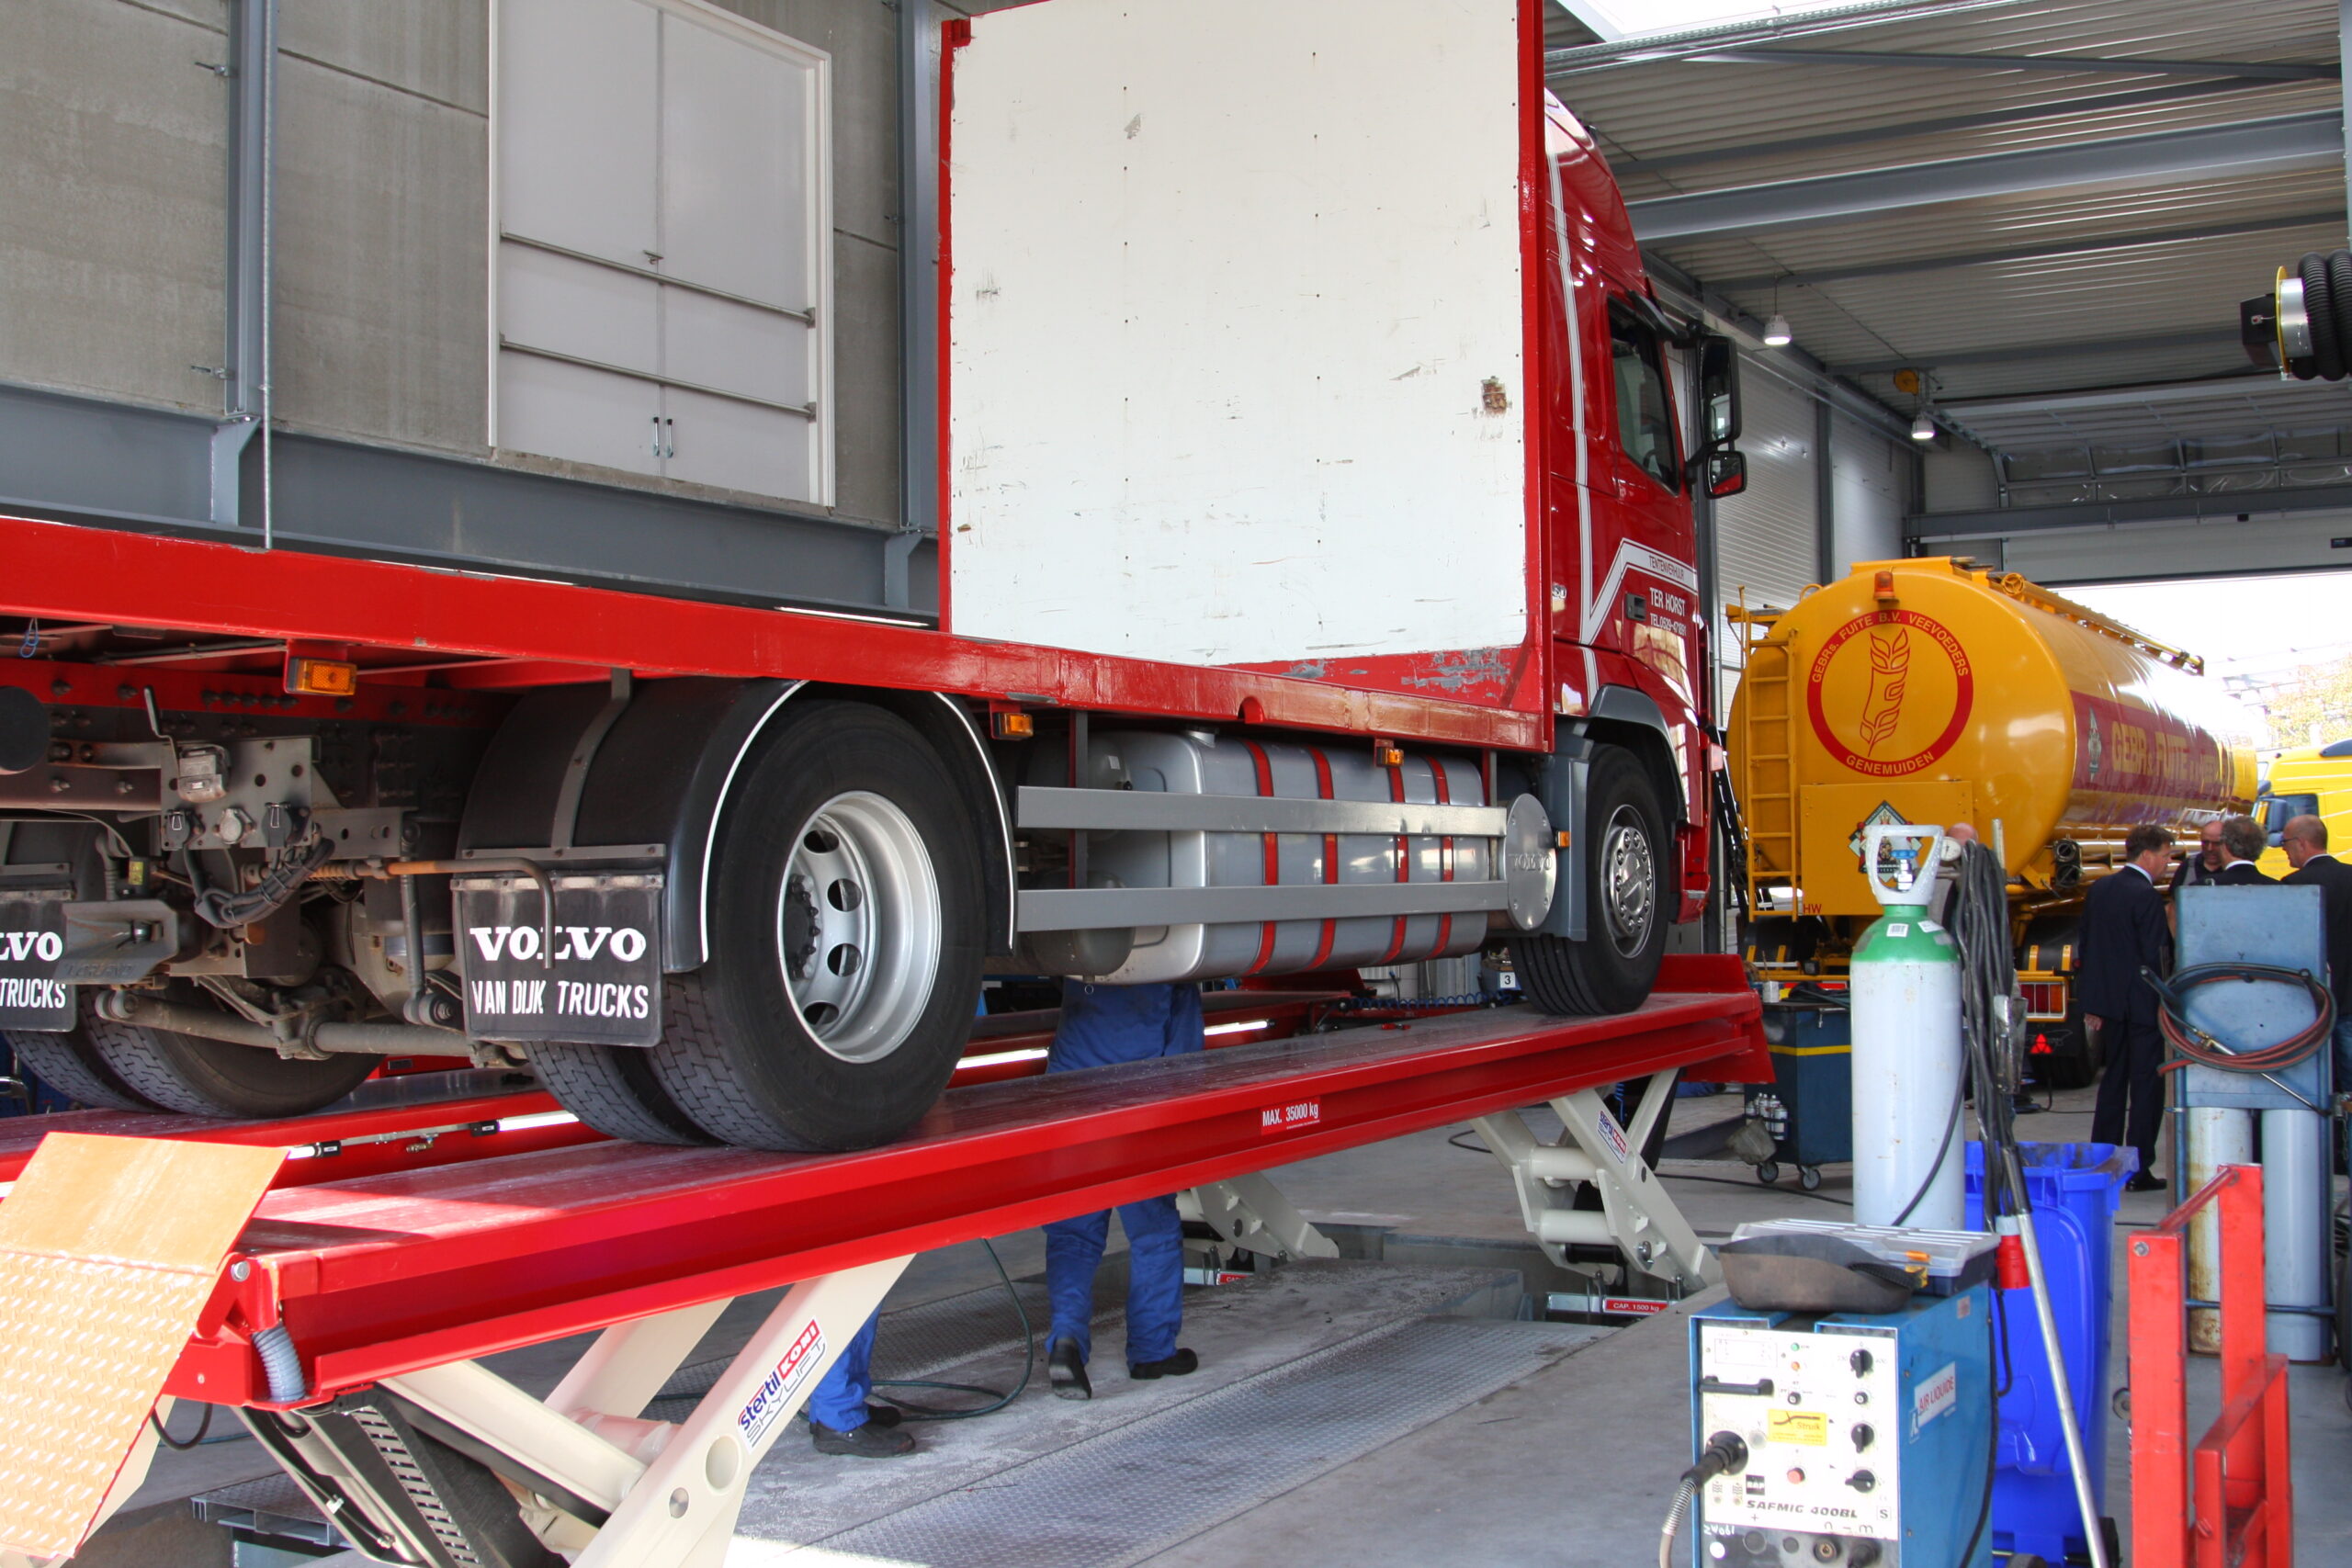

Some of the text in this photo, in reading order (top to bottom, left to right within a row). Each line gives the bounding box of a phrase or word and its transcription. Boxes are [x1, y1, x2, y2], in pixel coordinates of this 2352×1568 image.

[1649, 587, 1686, 616] TER HORST
[1812, 612, 1968, 682] GEBRs. FUITE B.V. VEEVOEDERS
[1846, 751, 1934, 774] GENEMUIDEN
[1508, 852, 1552, 874] VOLVO
[1804, 903, 1822, 914] HW
[469, 926, 647, 962] VOLVO
[1504, 975, 1511, 985] 3
[471, 979, 649, 1020] VAN DIJK TRUCKS
[1262, 1108, 1283, 1127] MAX.
[1285, 1102, 1308, 1122] 35000
[1308, 1101, 1319, 1119] kg
[1650, 1304, 1660, 1313] kg
[740, 1323, 819, 1431] stertil KONI
[747, 1337, 822, 1442] SKYLIFT
[1919, 1393, 1929, 1412] AIR
[1929, 1375, 1954, 1405] LIQUIDE
[1796, 1421, 1820, 1431] Struik
[1747, 1499, 1858, 1518] SAFMIG 400BL
[1880, 1508, 1889, 1519] S
